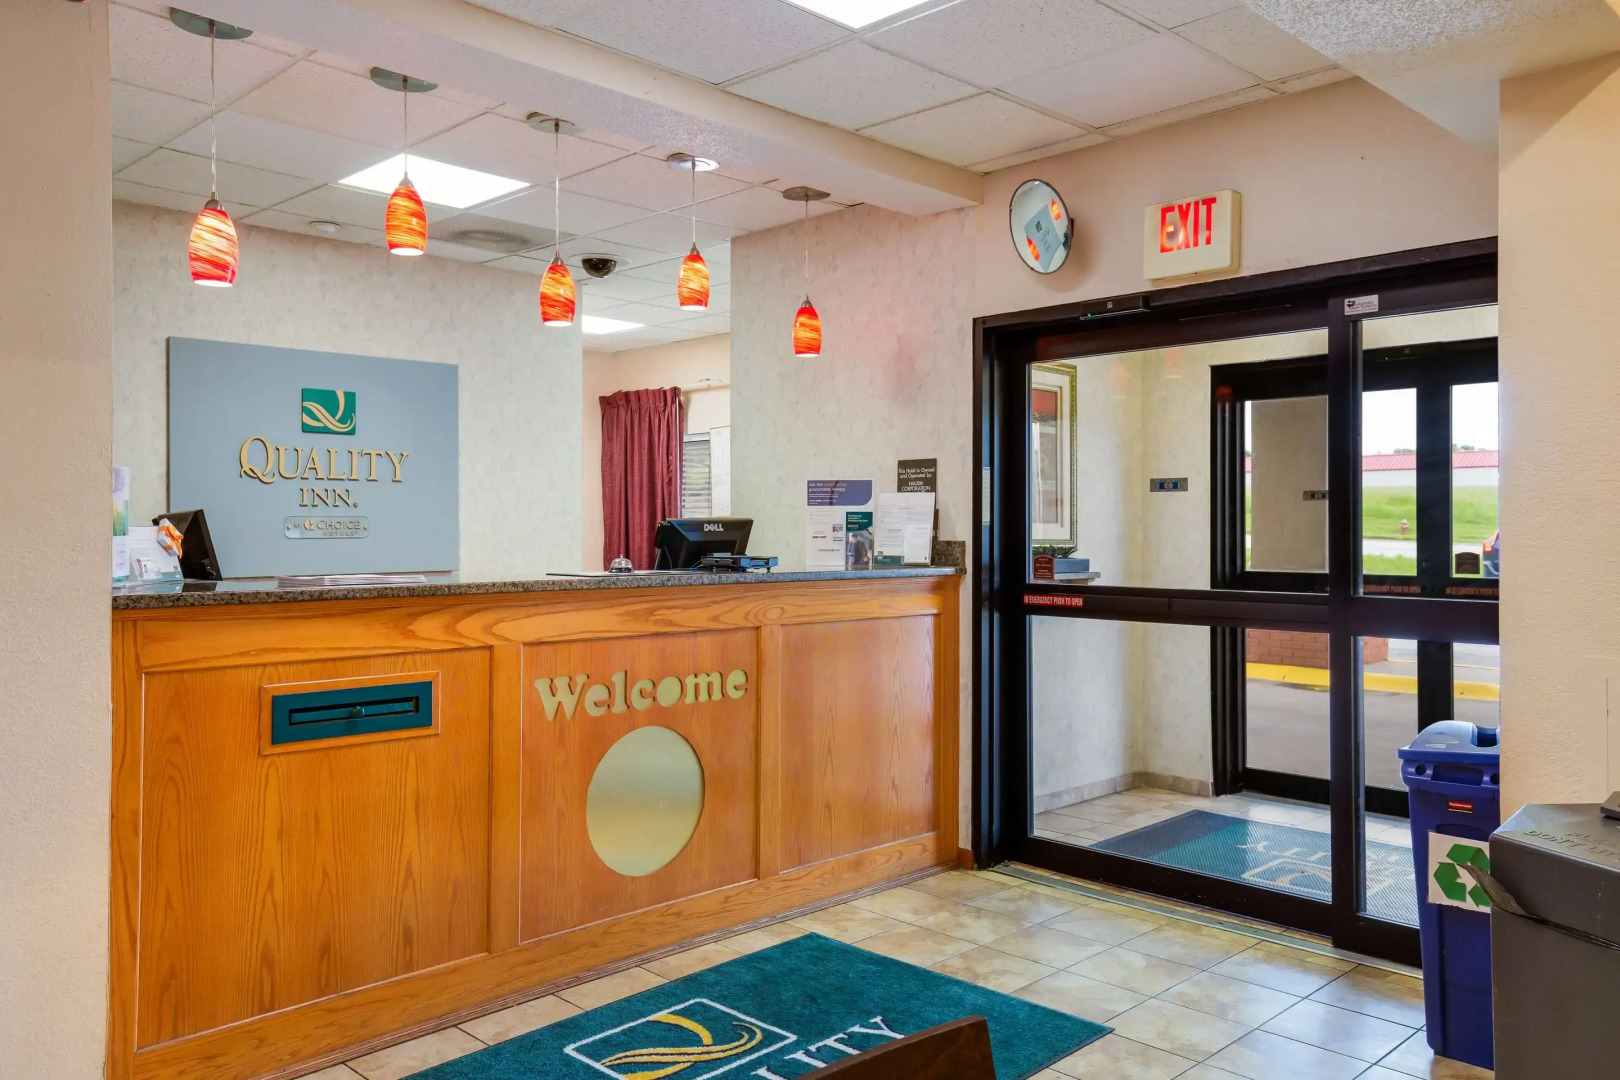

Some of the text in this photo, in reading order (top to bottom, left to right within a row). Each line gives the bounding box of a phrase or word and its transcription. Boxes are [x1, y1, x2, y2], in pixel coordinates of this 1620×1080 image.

[1160, 197, 1217, 253] EXIT
[240, 436, 409, 484] QUALITY
[316, 520, 361, 531] CHOICE
[703, 523, 724, 532] DELL
[1029, 596, 1053, 604] EMERGENCY
[1053, 596, 1065, 605] PUSH
[1065, 597, 1071, 605] TO
[1071, 597, 1083, 605] OPEN
[534, 669, 748, 722] Welcome
